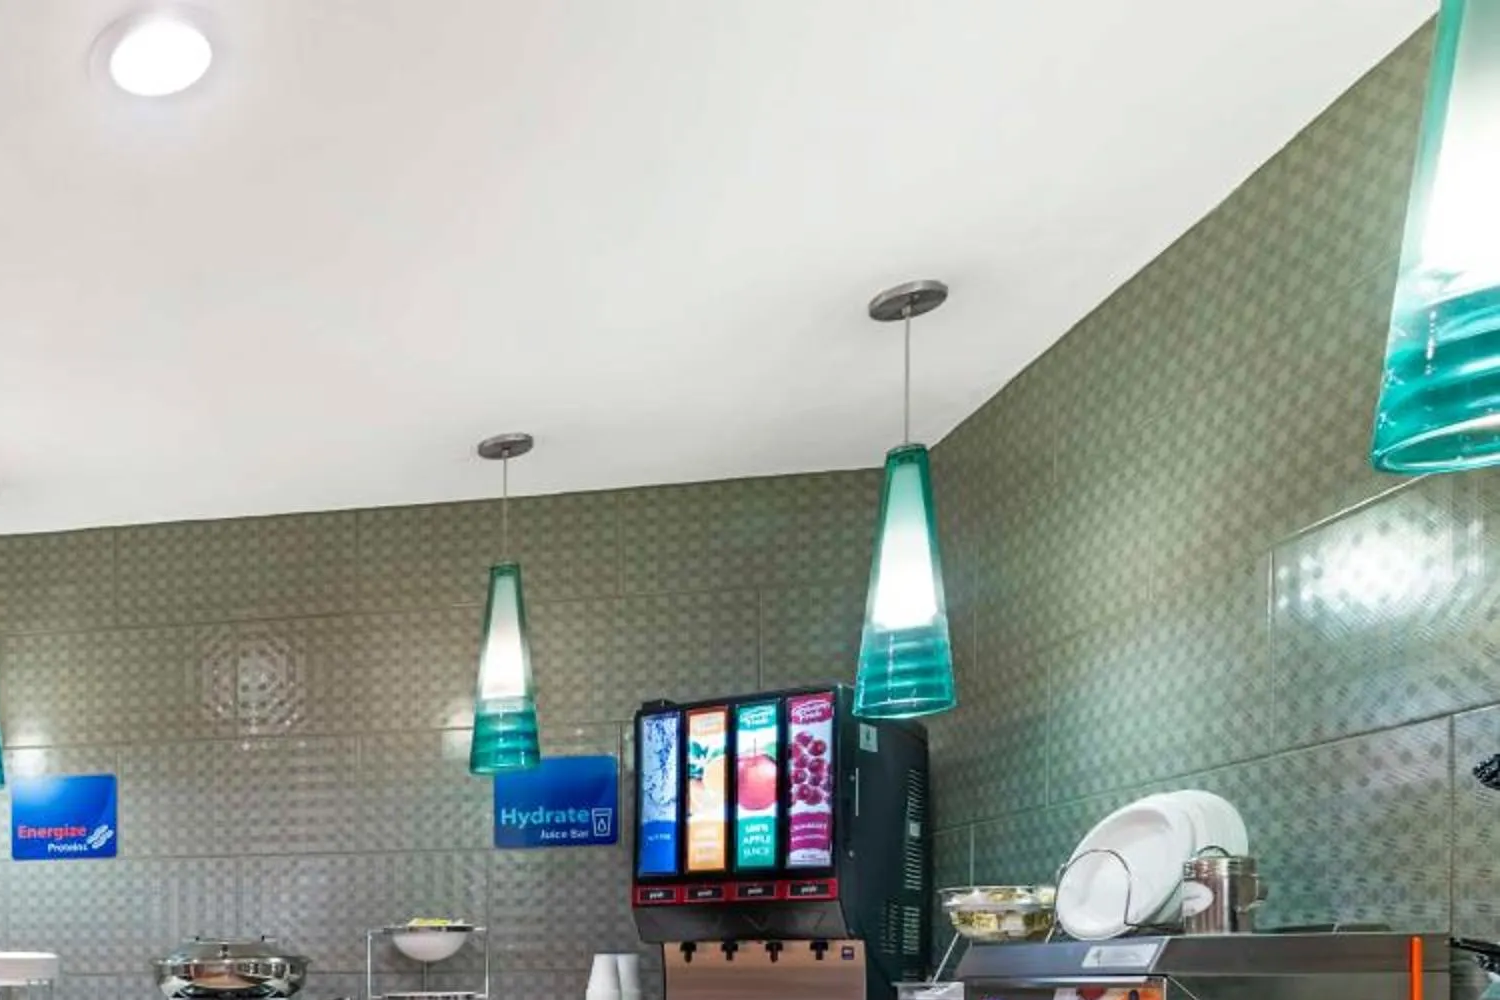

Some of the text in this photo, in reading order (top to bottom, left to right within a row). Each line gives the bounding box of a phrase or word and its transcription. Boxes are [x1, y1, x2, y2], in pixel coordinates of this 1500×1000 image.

[501, 806, 590, 829] Hydrate
[17, 825, 86, 842] Energize
[540, 829, 588, 839] Juice Bar
